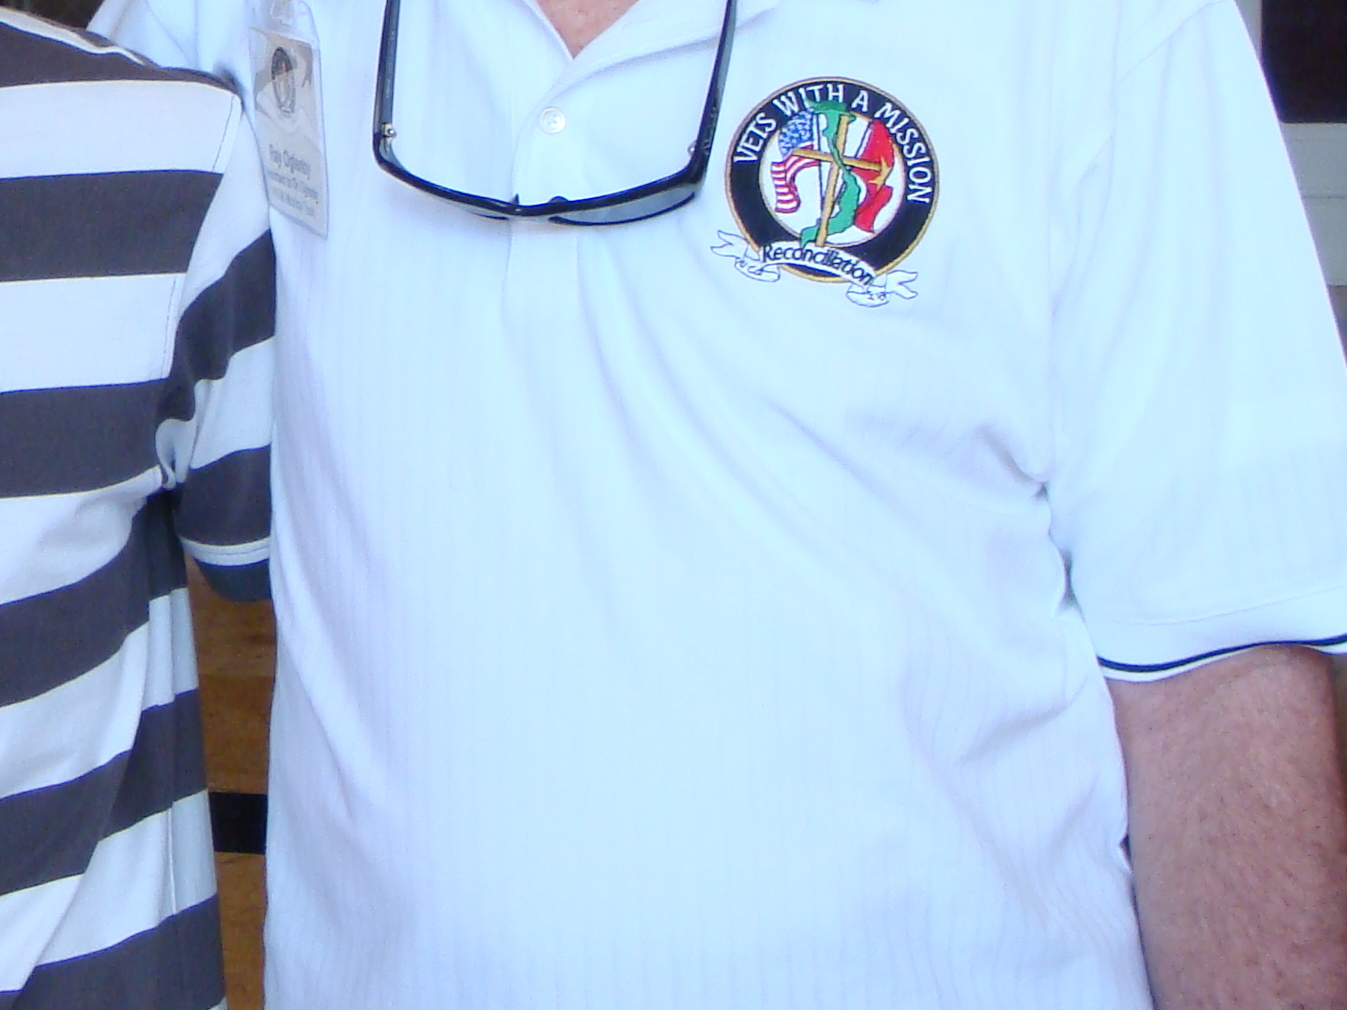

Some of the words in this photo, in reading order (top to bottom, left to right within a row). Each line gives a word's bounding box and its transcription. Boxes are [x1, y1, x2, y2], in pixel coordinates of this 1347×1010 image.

[734, 113, 776, 163] VETS
[772, 84, 844, 117] WITH
[851, 90, 870, 112] A
[874, 103, 933, 204] MISSION
[762, 243, 874, 286] Reconciliation
